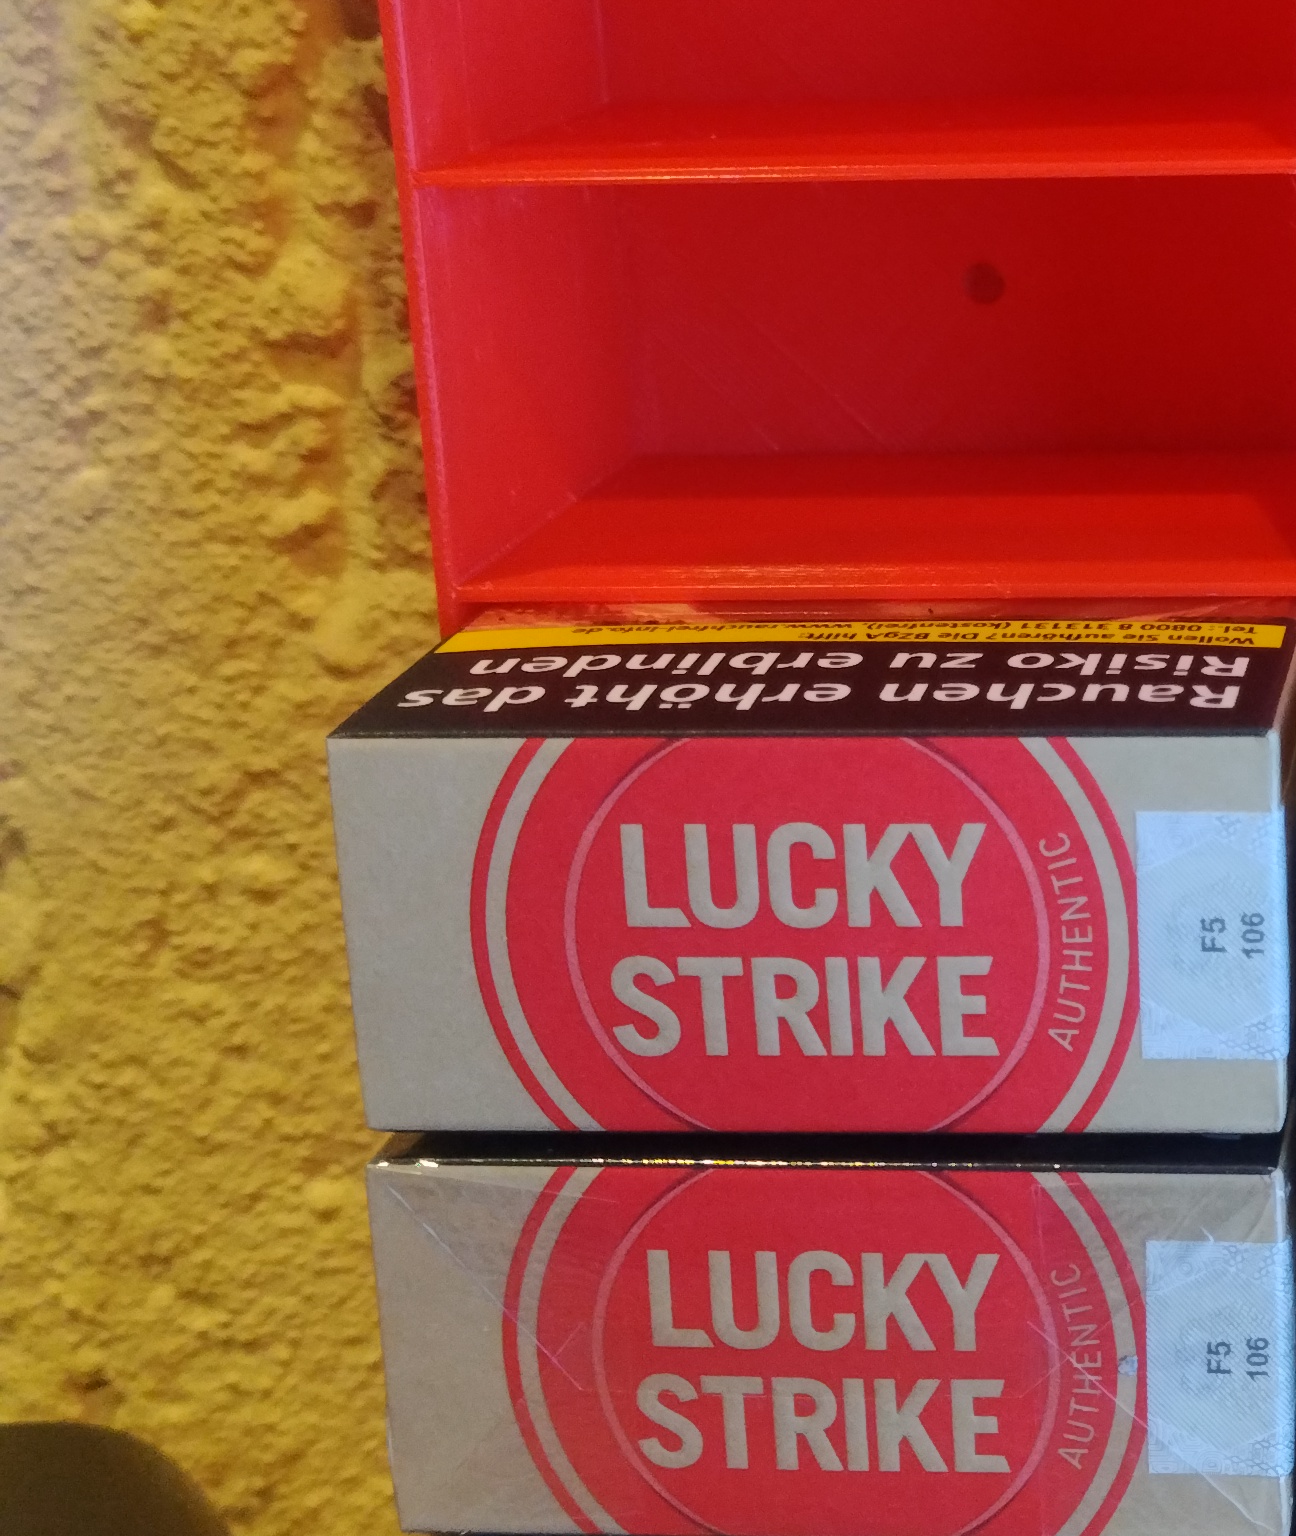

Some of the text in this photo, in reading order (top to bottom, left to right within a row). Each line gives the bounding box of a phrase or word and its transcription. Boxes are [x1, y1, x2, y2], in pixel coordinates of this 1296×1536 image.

[865, 631, 930, 640] BZgA
[938, 631, 979, 640] Die
[985, 632, 1115, 641] aufhören?
[1020, 622, 1110, 631] 313131
[1123, 633, 1160, 642] Sie
[1141, 624, 1202, 632] 0800
[1168, 633, 1254, 645] Wollen
[469, 652, 1250, 678] Risiko zu erblinden
[397, 683, 1241, 713] Rauchen erhöht das
[618, 822, 987, 929] LUCKY
[1038, 832, 1094, 1052] AUTHENTIC
[1200, 916, 1227, 954] F5
[1241, 912, 1265, 959] 106
[609, 955, 999, 1058] STRIKE
[645, 1248, 1000, 1354] LUCKY
[1050, 1263, 1104, 1470] AUTHENTIC
[1206, 1341, 1232, 1375] F5
[1245, 1337, 1270, 1382] 106
[635, 1373, 1012, 1475] STRIKE
